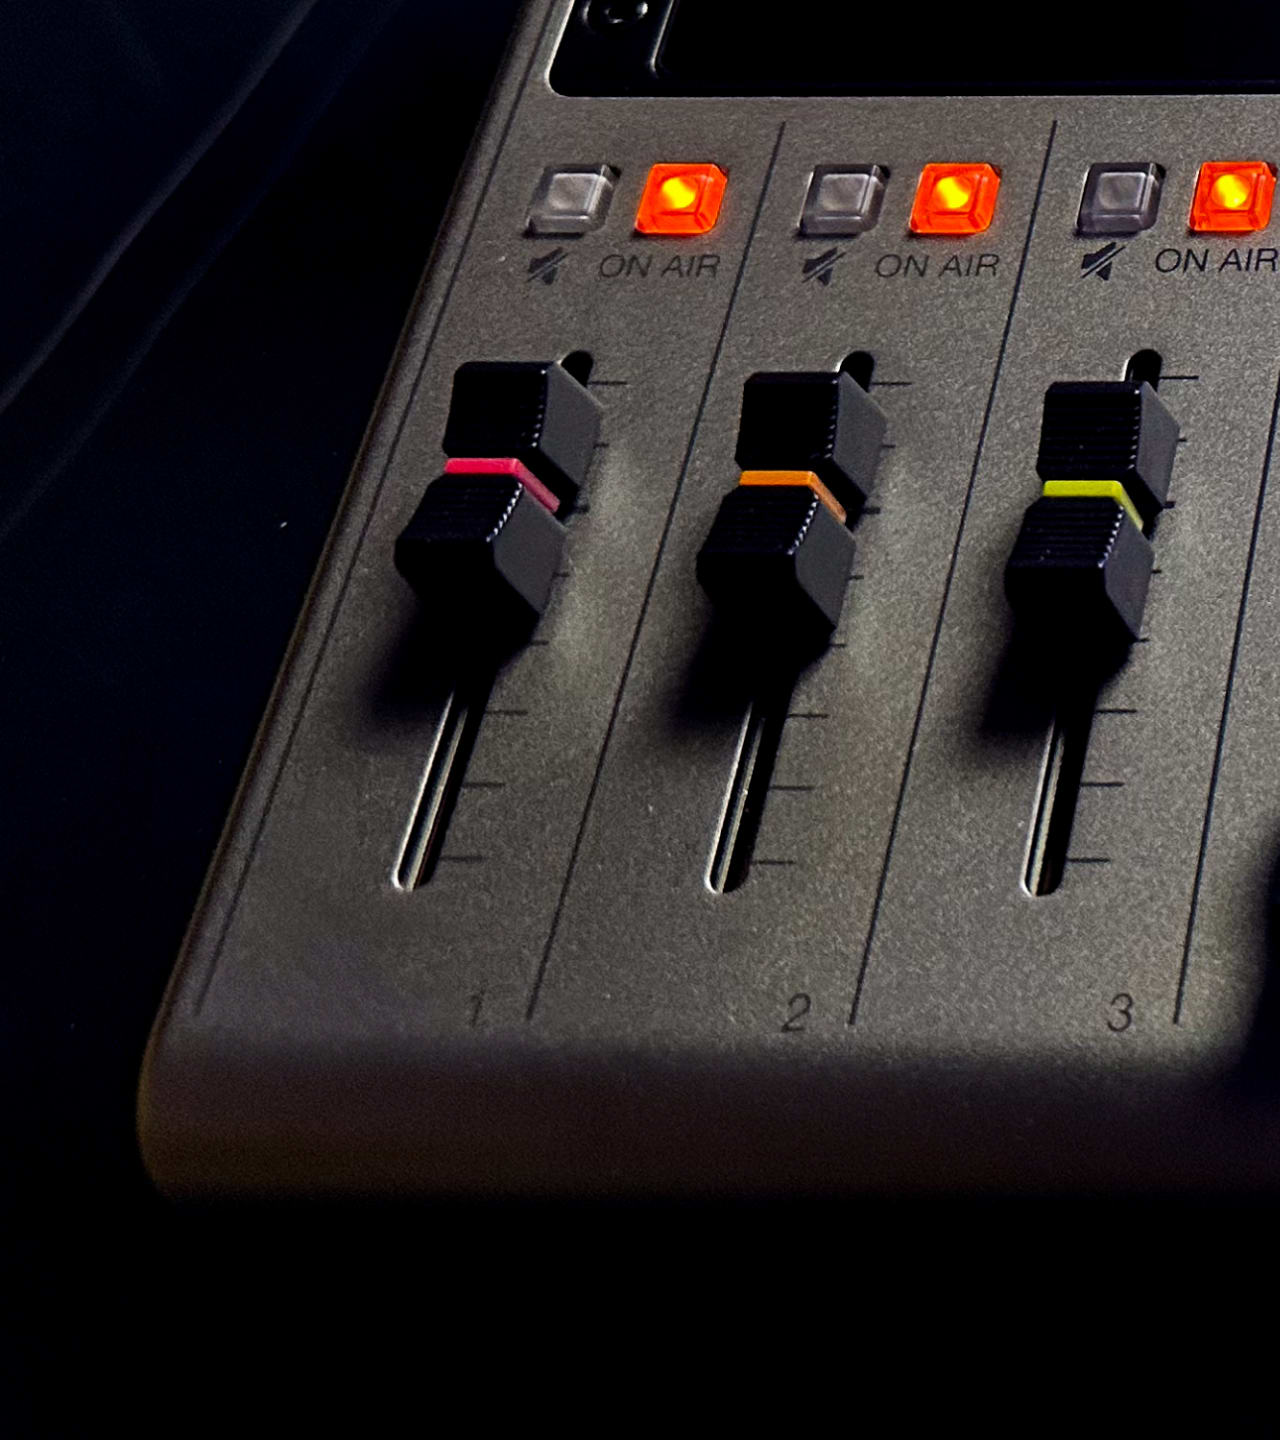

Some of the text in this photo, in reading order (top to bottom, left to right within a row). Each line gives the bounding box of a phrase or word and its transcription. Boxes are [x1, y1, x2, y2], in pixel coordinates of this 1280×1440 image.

[599, 253, 722, 278] ON AIR
[874, 253, 1001, 278] ON AIR
[1154, 247, 1280, 273] ON AIR
[468, 986, 487, 1027] 1
[780, 991, 813, 1033] 2
[1106, 992, 1134, 1033] 3
